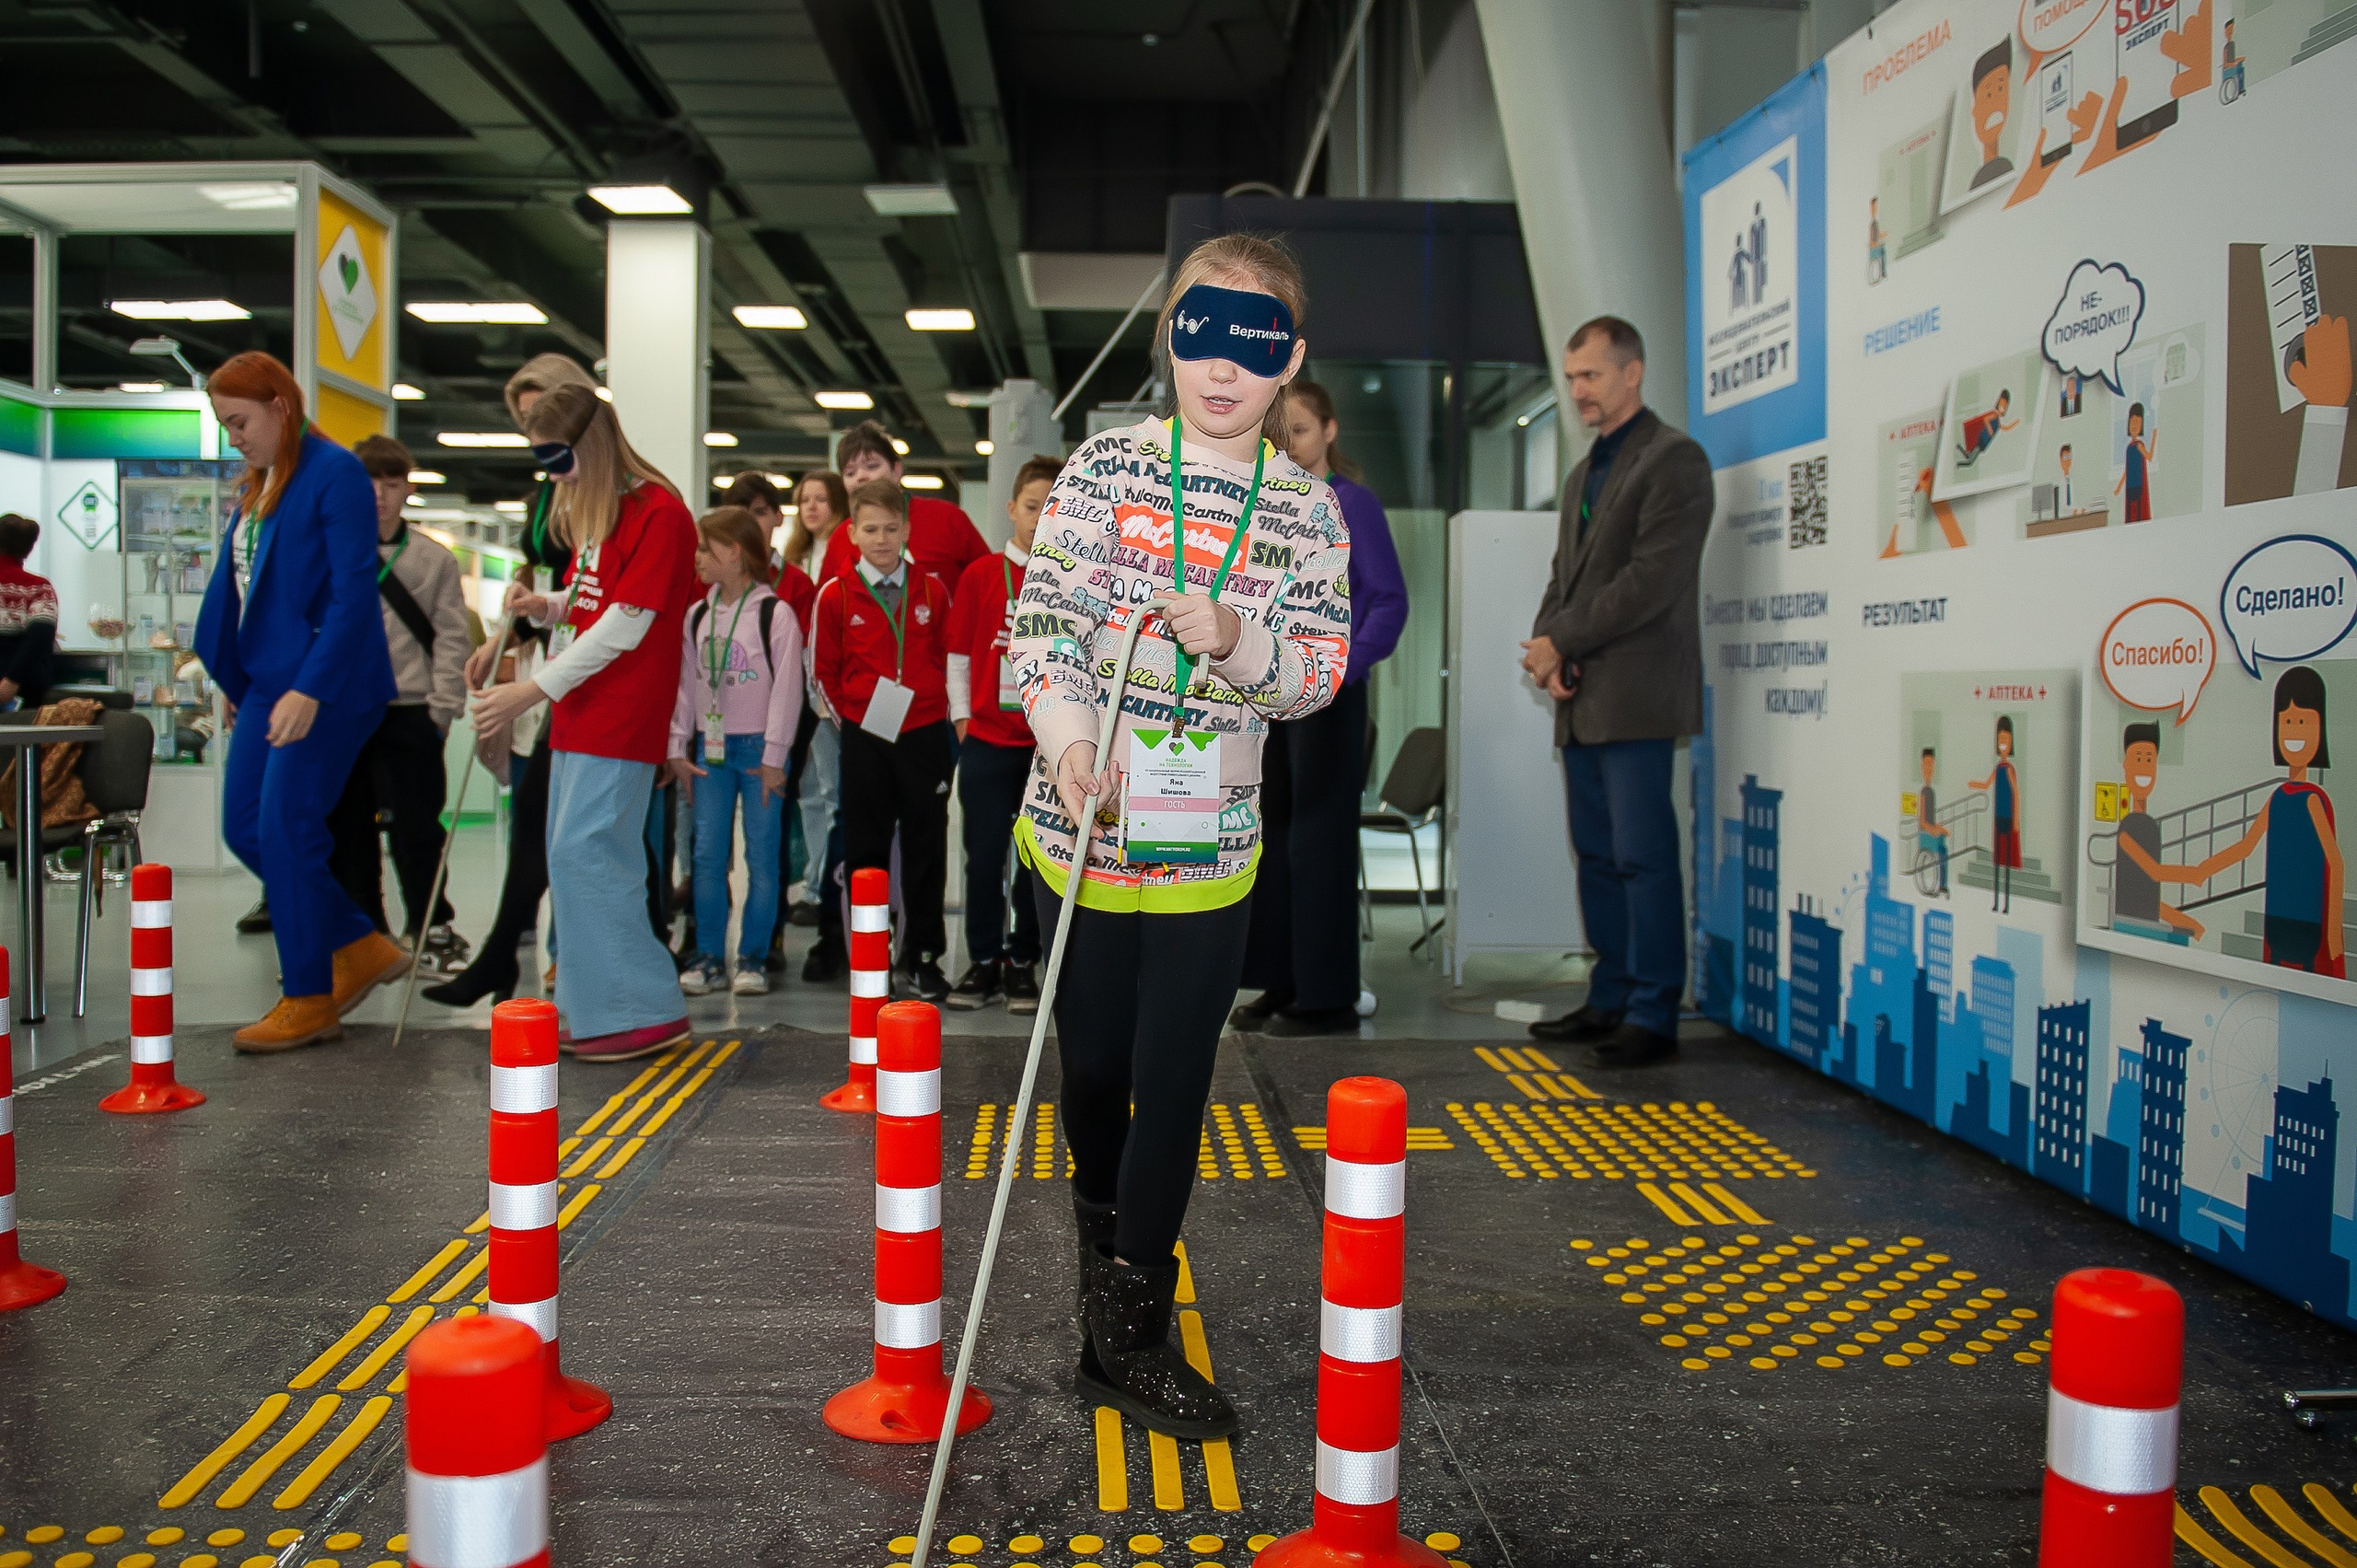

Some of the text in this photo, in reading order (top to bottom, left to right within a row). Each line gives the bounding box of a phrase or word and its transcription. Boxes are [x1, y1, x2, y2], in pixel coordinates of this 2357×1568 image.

[2115, 0, 2177, 35] SO
[1863, 18, 1952, 96] ПРОБЛЕМА
[2081, 291, 2103, 312] НЕ-
[1229, 324, 1290, 342] Вертикаль
[1864, 305, 1941, 357] РЕШЕНИЕ
[2055, 305, 2131, 345] ПОРЯДОК!!!
[1710, 340, 1791, 398] ЭКСПЕРТ
[1080, 436, 1132, 463] SMC
[1253, 497, 1301, 518] Stella
[2236, 576, 2345, 616] Сделано!
[1014, 610, 1078, 641] SMC
[1864, 597, 1948, 627] РЕЗУЛЬТАТ
[2112, 637, 2204, 667] Спасибо!
[1988, 685, 2035, 701] АПТЕКА
[1160, 788, 1191, 796] Шишова
[1169, 778, 1184, 786] Яна
[1164, 800, 1186, 808] ГОСТЬ
